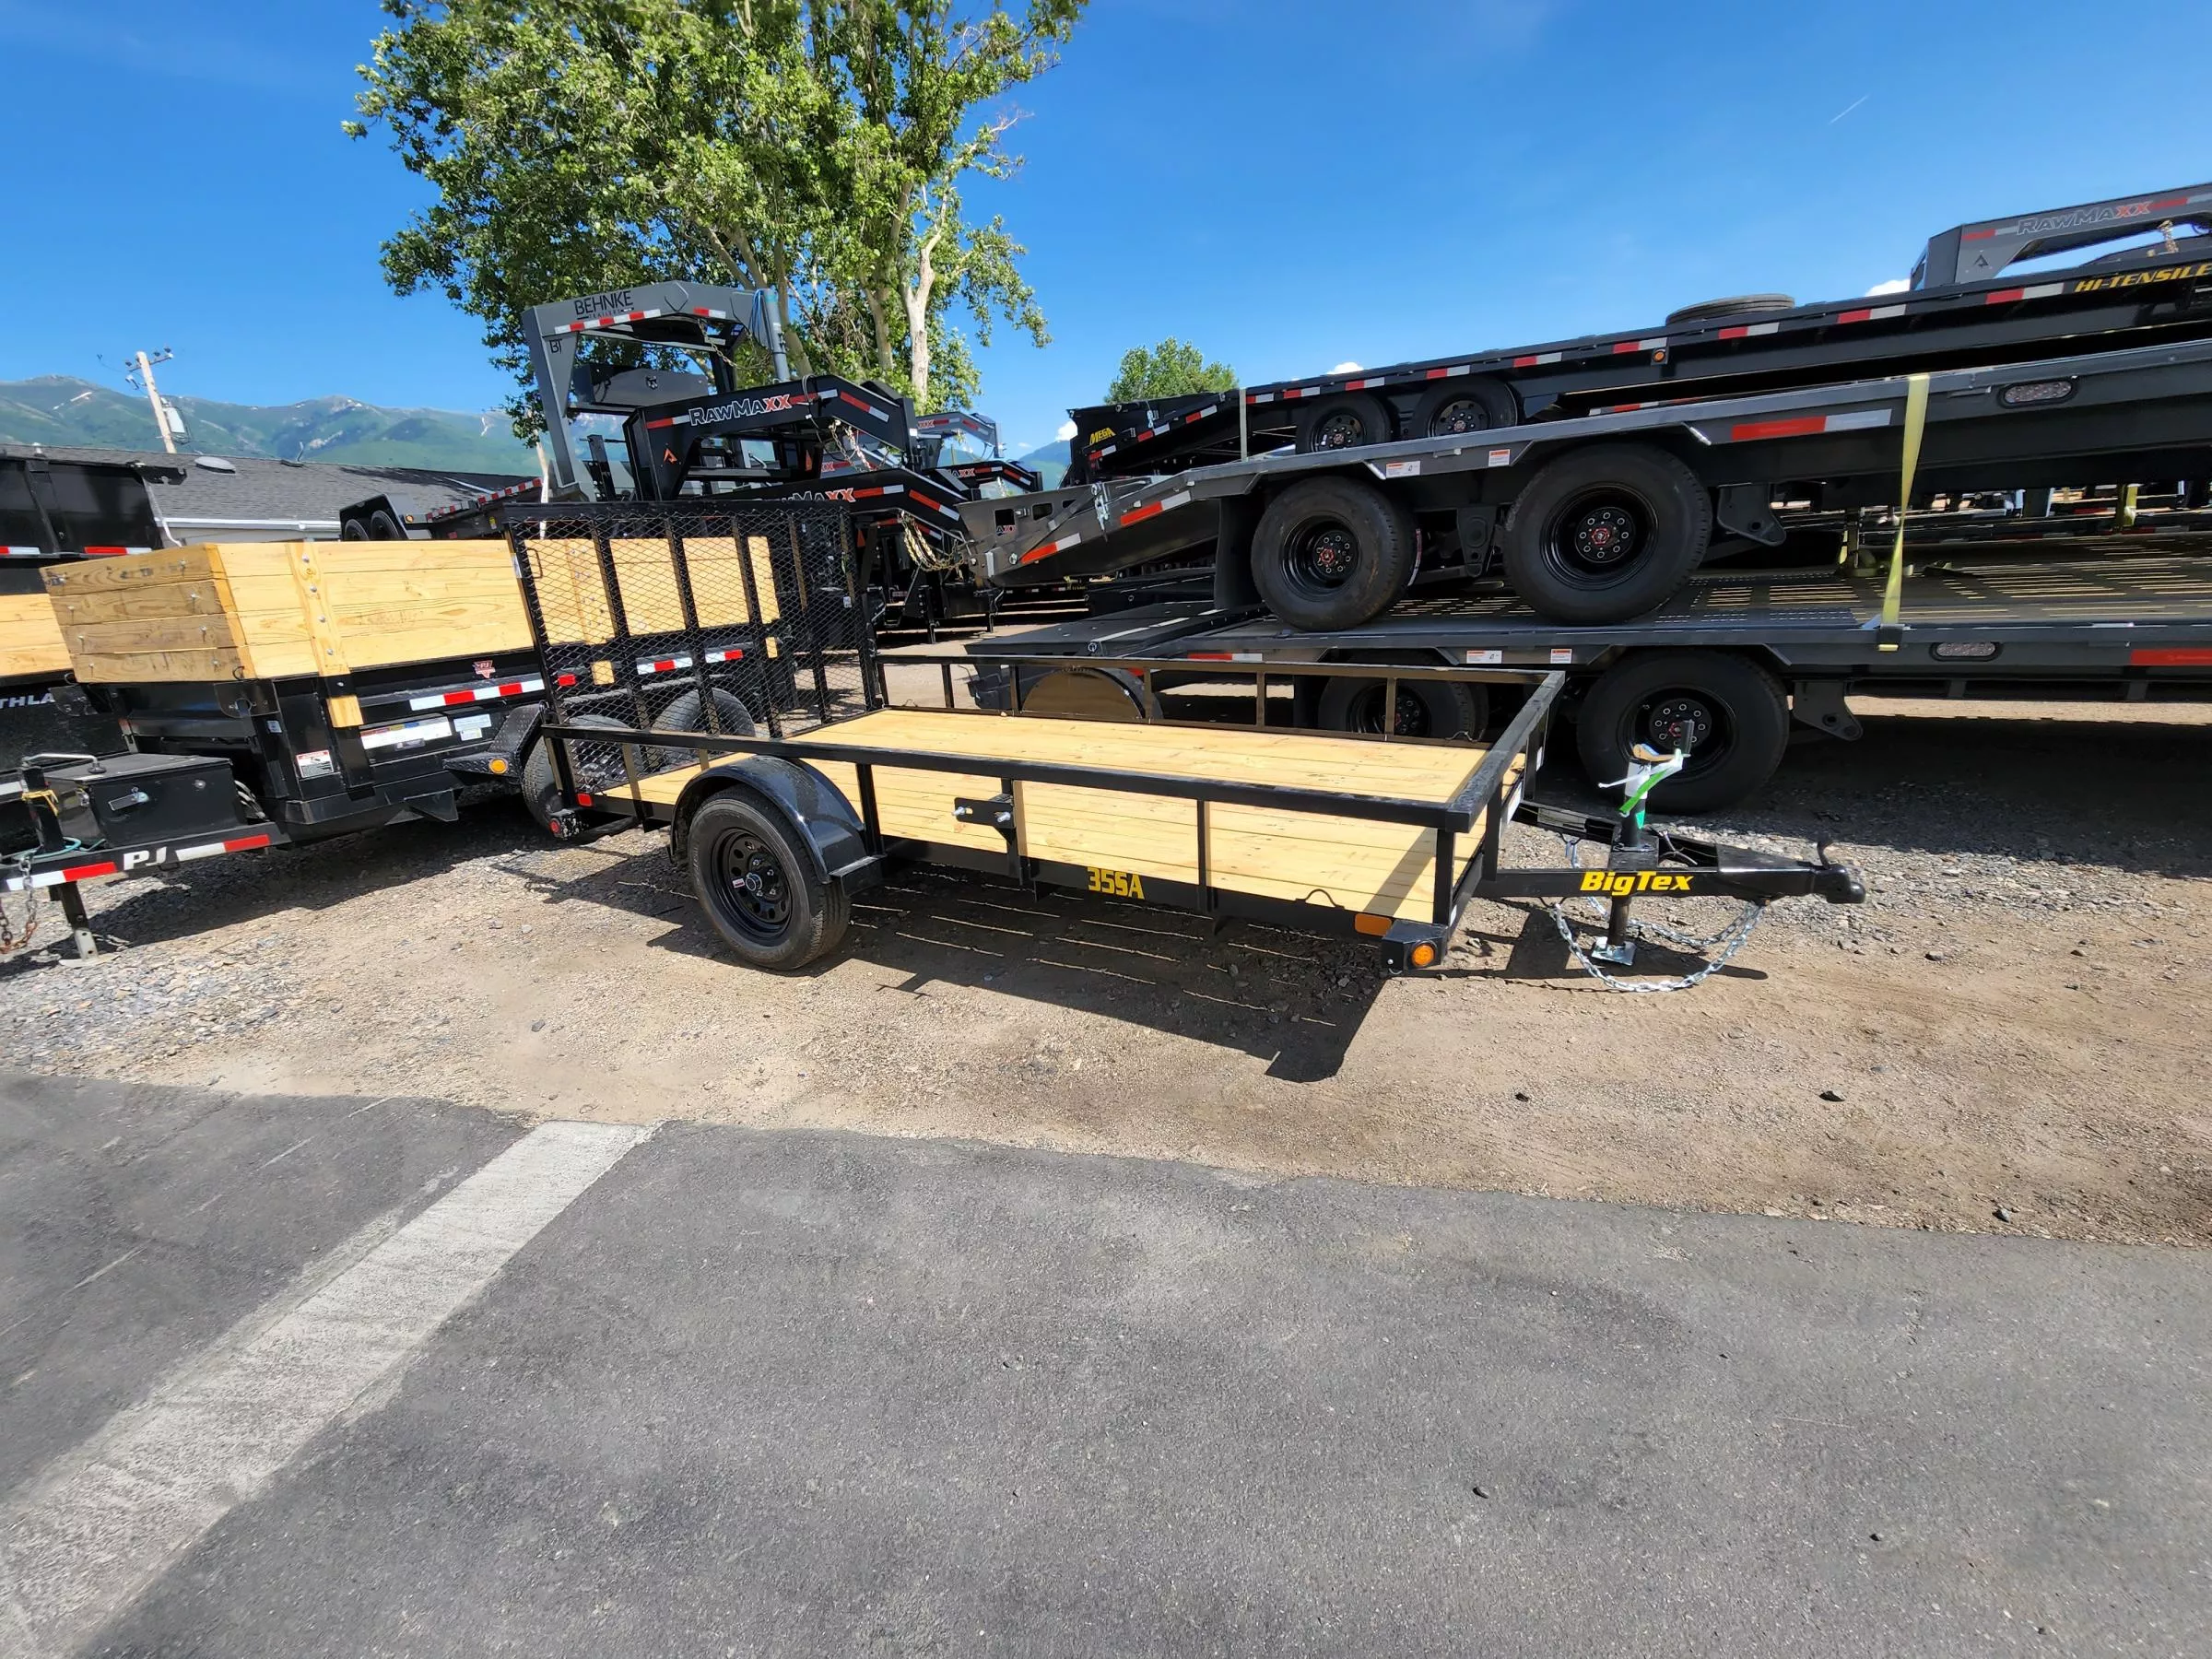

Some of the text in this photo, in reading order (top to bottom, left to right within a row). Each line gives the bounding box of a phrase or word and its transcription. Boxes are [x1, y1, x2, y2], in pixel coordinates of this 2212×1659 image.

[2075, 264, 2212, 292] HI-TENSILE
[574, 290, 633, 314] BEHNKE
[1089, 427, 1116, 445] MEGA
[123, 846, 167, 871] PJ
[1088, 866, 1146, 900] 35SA
[1579, 870, 1695, 896] BigTex
